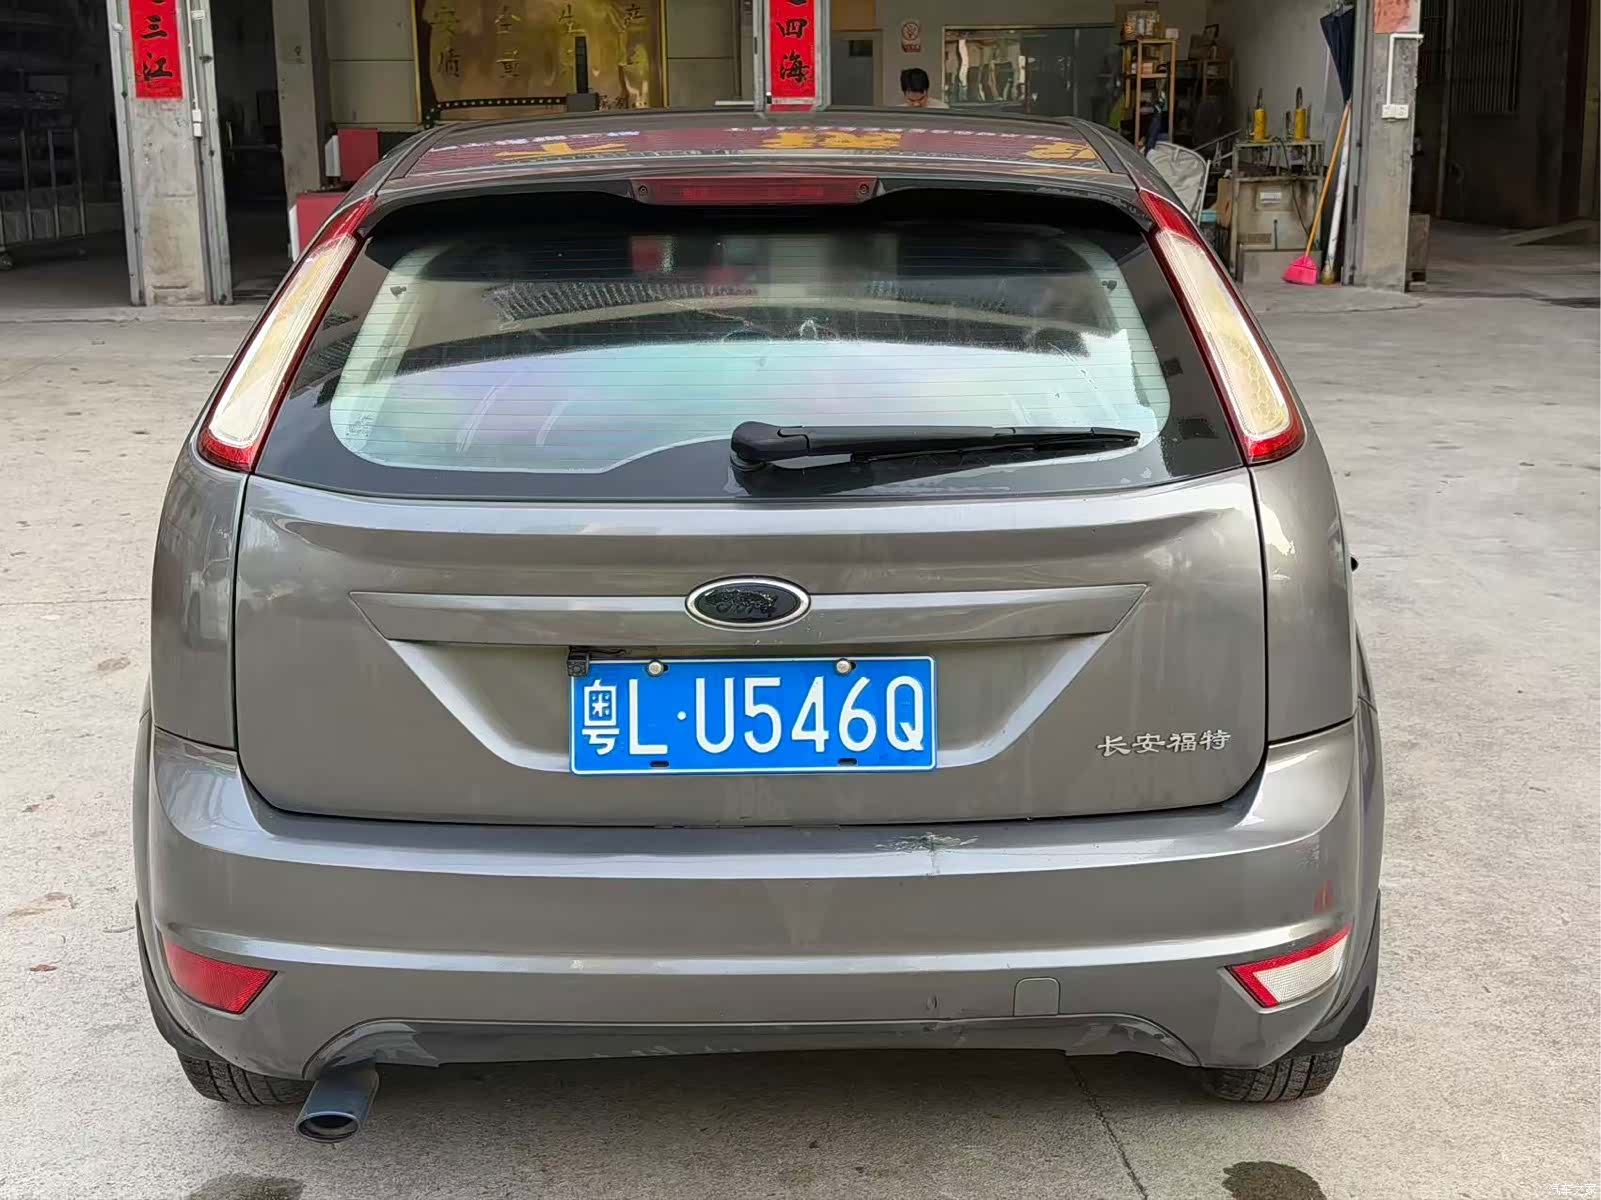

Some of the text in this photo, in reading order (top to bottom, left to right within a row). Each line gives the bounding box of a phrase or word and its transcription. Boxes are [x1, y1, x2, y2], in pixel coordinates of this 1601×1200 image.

[140, 0, 174, 82] 三江
[775, 0, 810, 83] 四海
[1097, 729, 1231, 757] 长安福特
